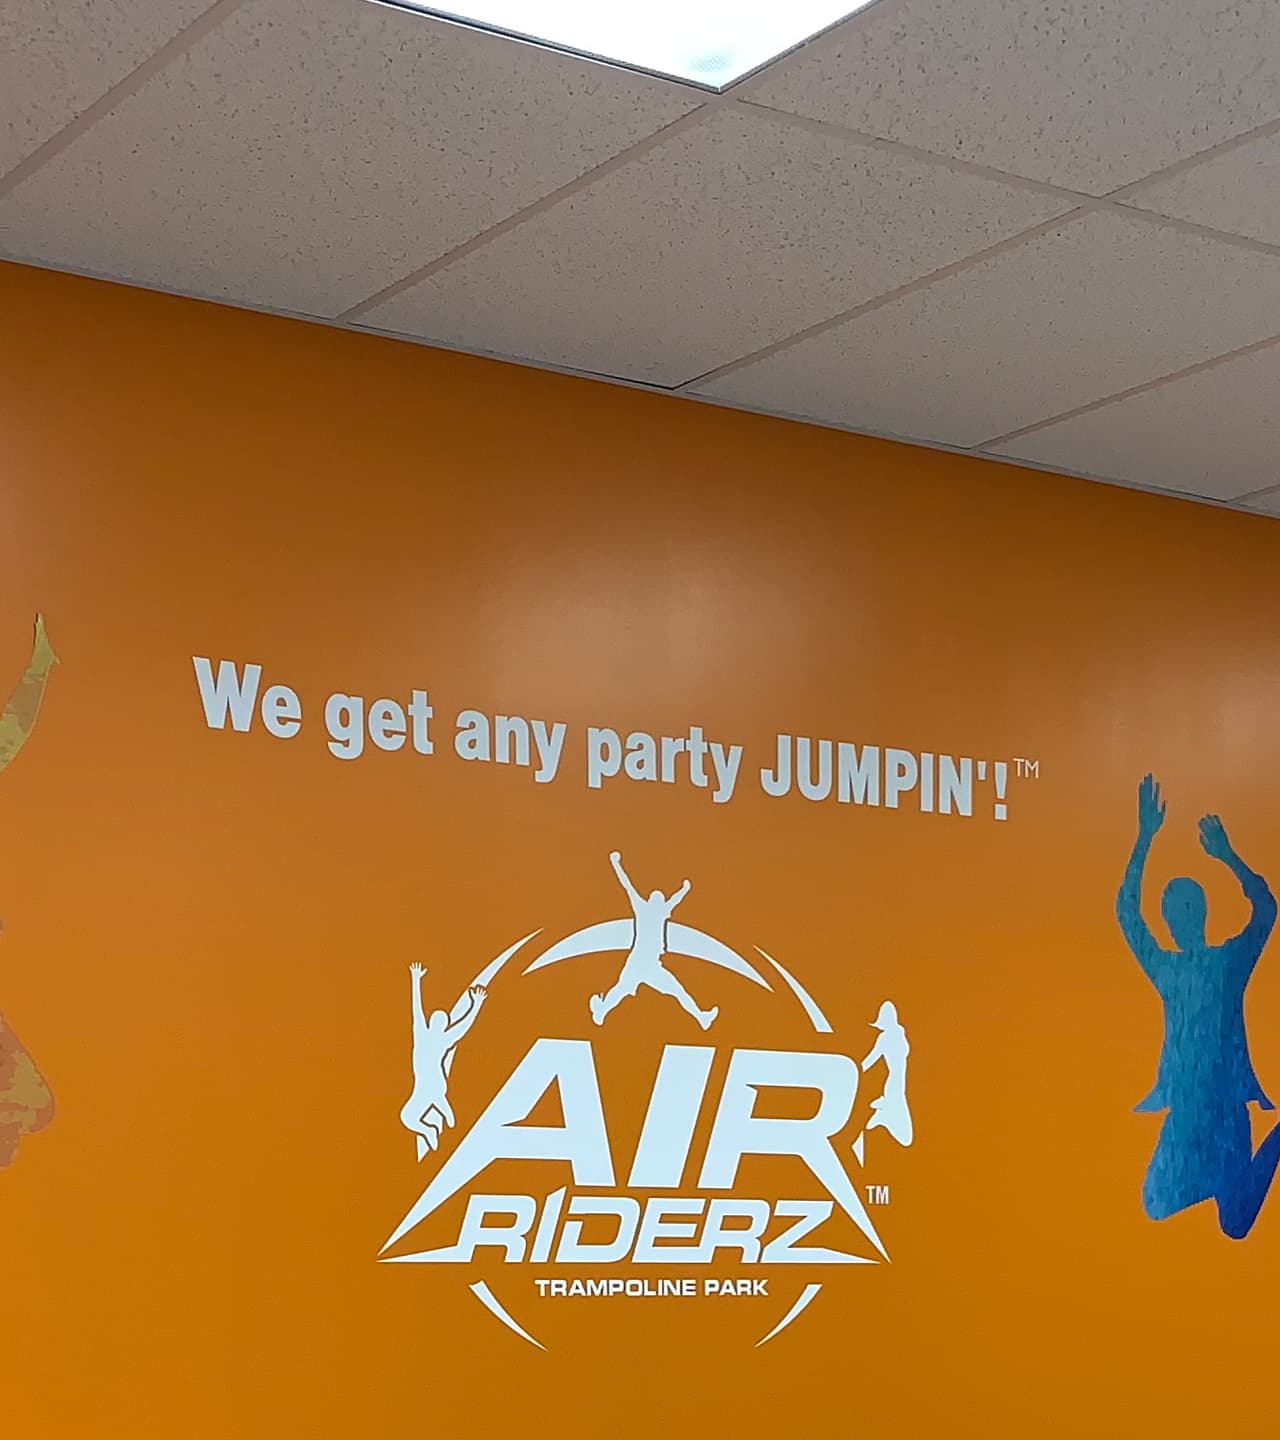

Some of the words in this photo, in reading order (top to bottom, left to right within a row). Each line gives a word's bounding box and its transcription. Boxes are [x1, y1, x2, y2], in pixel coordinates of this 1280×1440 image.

[192, 656, 302, 739] We
[324, 689, 434, 760] get
[454, 709, 568, 784] any
[587, 727, 743, 804] party
[378, 1037, 891, 1264] AIR
[378, 1186, 881, 1264] RIDERZ
[534, 1279, 697, 1297] TRAMPOLINE
[704, 1279, 769, 1297] PARK
